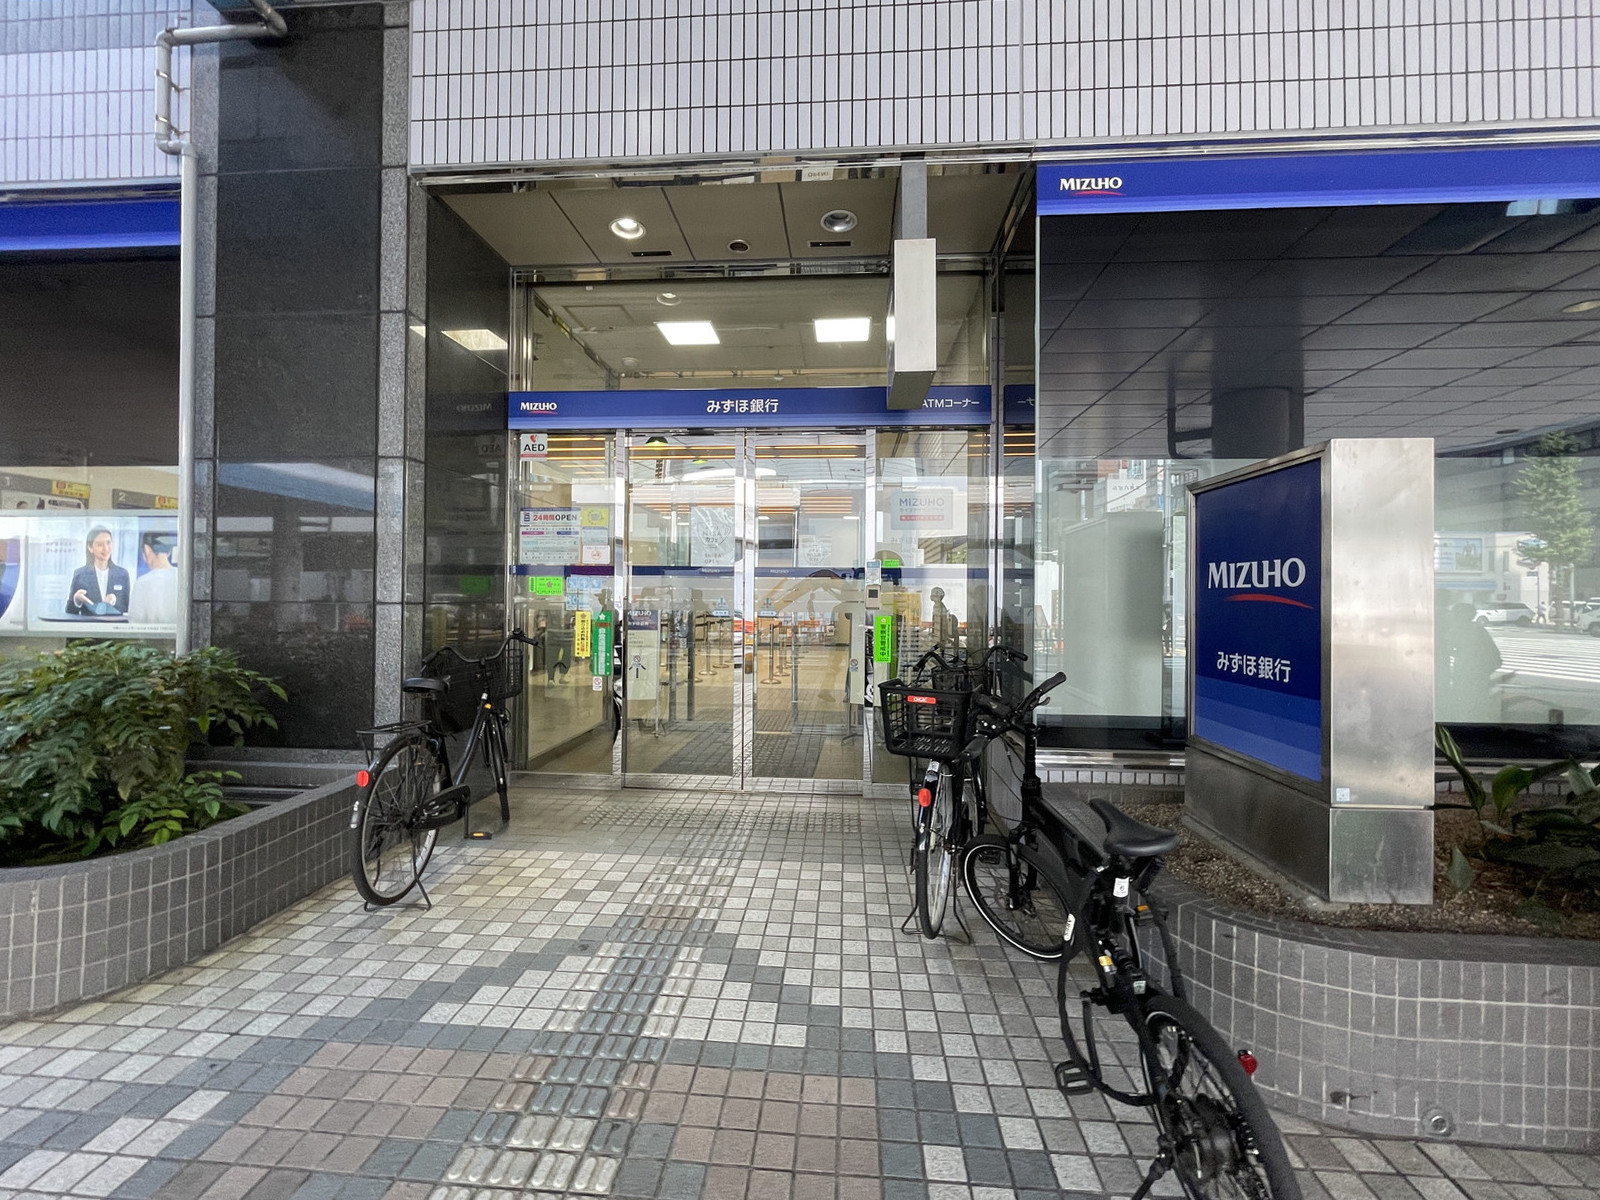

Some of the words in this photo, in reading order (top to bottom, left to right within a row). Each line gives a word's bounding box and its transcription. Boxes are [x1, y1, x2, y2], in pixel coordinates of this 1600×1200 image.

[1059, 176, 1123, 192] MIZUHO
[520, 401, 557, 412] MIZUHO
[706, 398, 779, 414] みずほ銀行
[922, 398, 980, 408] ATMコーナー
[523, 443, 545, 452] AED
[118, 492, 126, 502] 2
[899, 498, 944, 506] MIZUHO
[1207, 556, 1307, 590] MIZUHO
[1216, 650, 1292, 684] みずほ銀行
